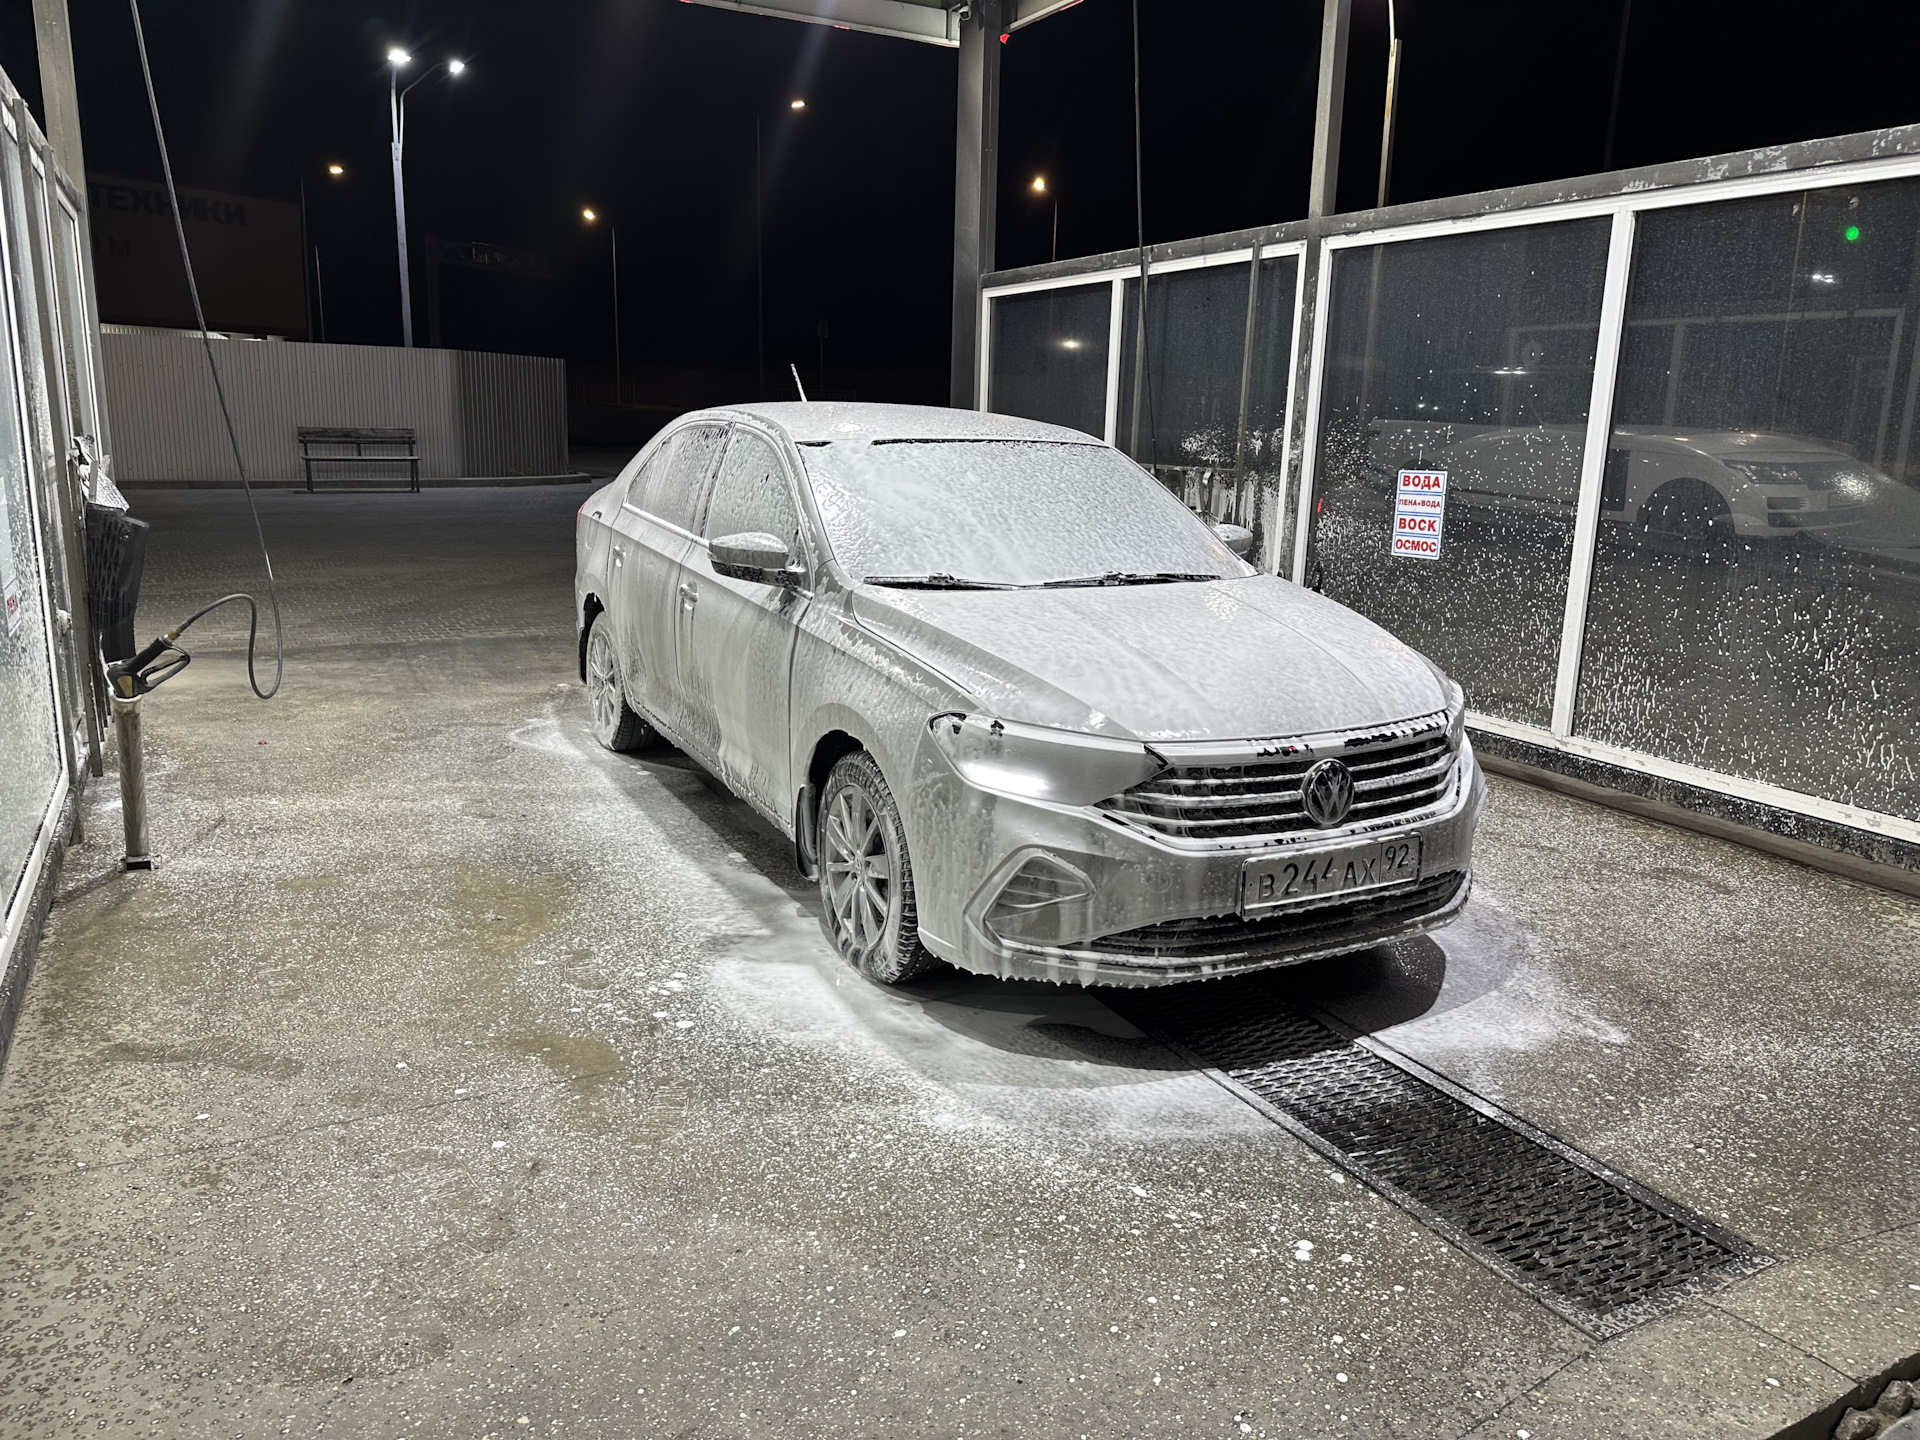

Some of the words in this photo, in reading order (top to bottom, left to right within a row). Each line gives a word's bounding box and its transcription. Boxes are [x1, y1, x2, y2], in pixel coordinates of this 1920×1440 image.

[1402, 475, 1441, 490] ВОДА
[1399, 498, 1441, 509] ПЕНА+ВОДА
[1398, 517, 1437, 532] ВОСК
[1395, 538, 1437, 553] ОСМОС
[1385, 843, 1410, 871] 92
